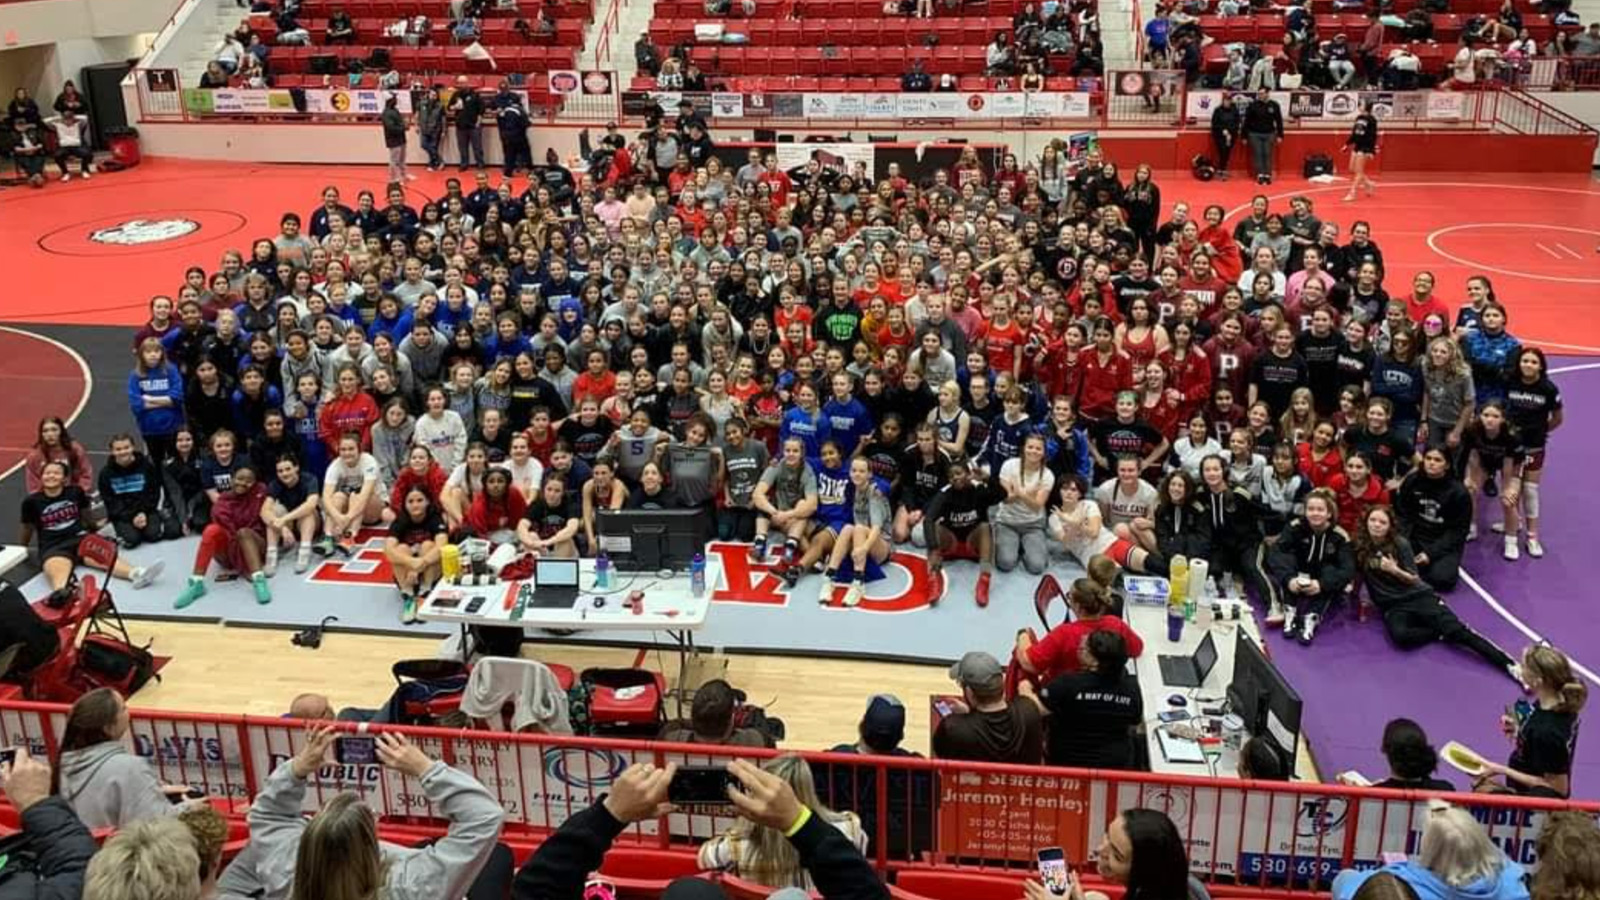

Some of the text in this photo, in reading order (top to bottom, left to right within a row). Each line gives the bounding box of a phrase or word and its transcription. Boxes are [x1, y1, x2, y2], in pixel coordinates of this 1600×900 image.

[1158, 303, 1175, 325] P
[1219, 354, 1238, 379] P
[631, 442, 644, 456] S
[1077, 692, 1083, 700] A
[1085, 692, 1102, 700] WAY
[1103, 693, 1114, 702] OF
[134, 734, 221, 761] DAVIS
[942, 788, 1015, 808] Jeremy
[1019, 792, 1089, 814] Henley
